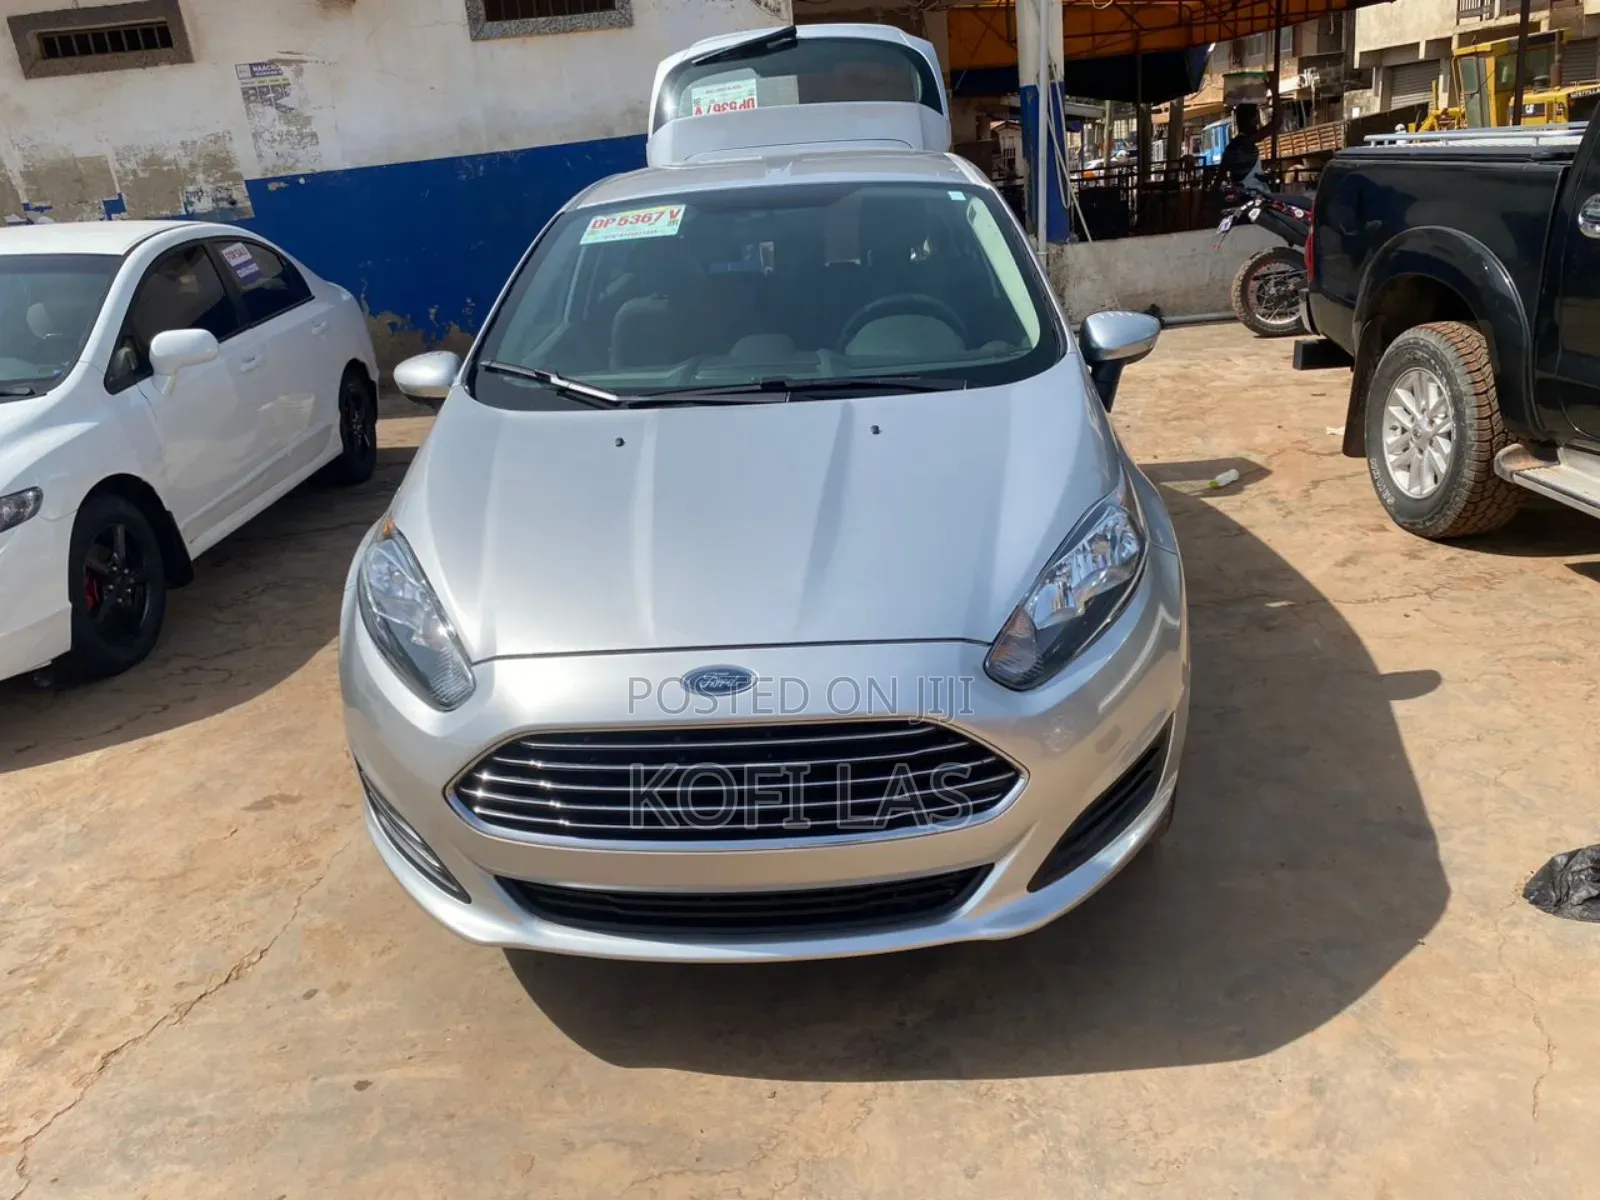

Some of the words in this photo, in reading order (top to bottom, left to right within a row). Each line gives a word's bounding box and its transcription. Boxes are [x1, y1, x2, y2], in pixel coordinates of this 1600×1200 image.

[617, 211, 665, 226] 5367
[669, 208, 681, 220] V
[697, 670, 742, 689] Ford
